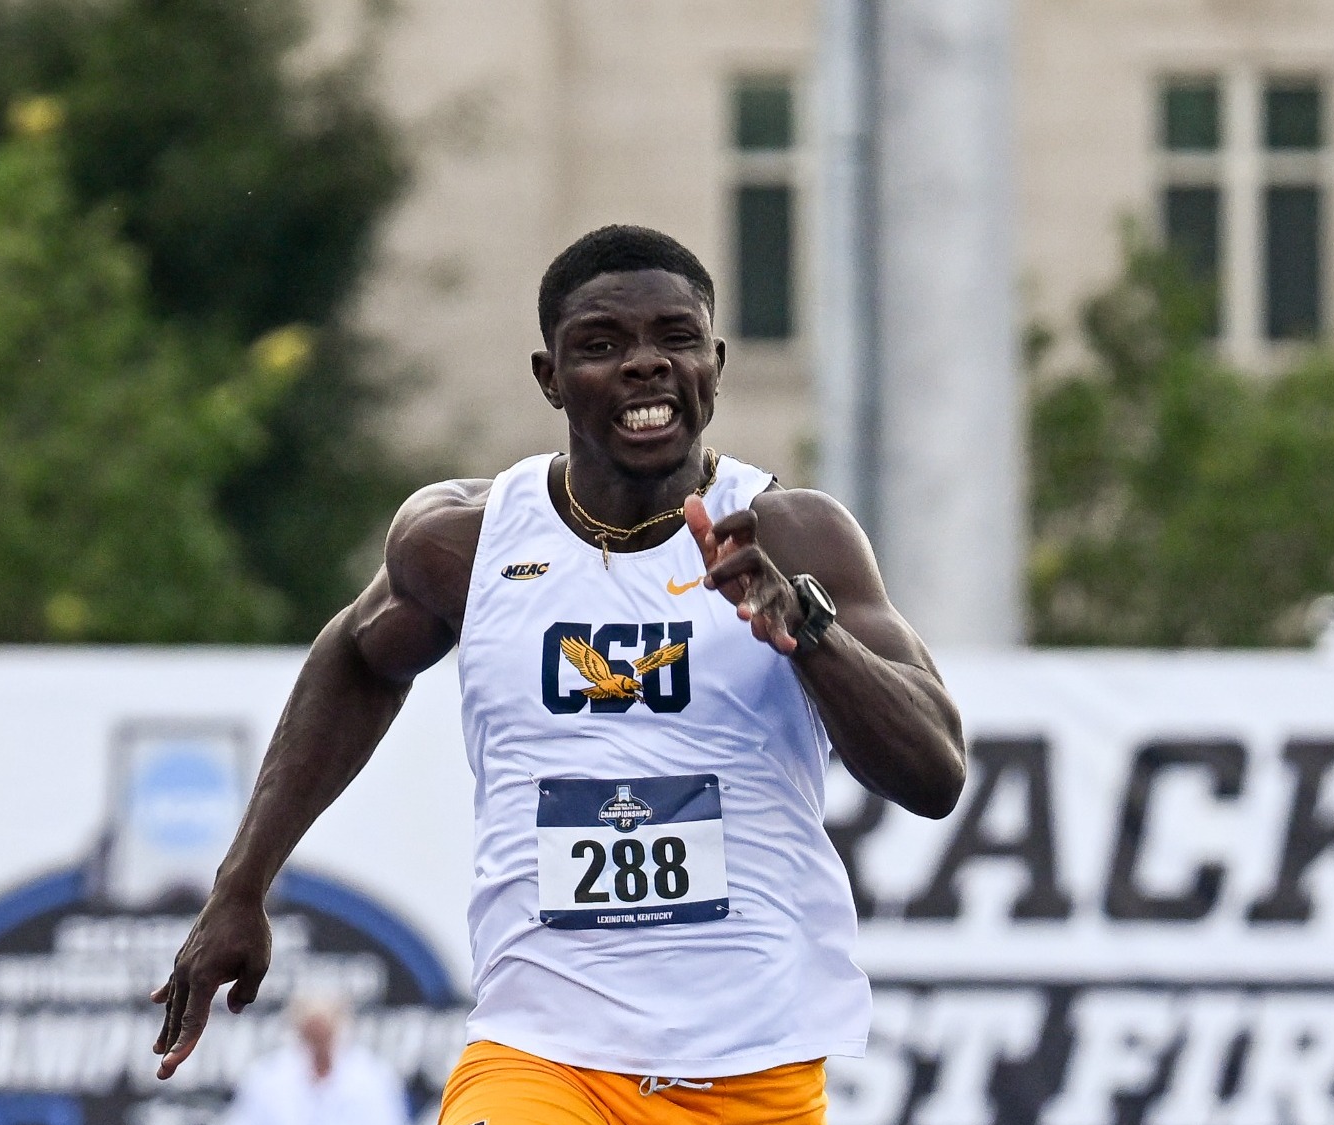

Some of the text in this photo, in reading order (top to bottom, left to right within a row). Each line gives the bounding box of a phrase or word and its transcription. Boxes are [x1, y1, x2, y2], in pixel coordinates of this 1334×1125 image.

[505, 562, 550, 577] MEAC
[542, 620, 693, 715] CSU
[571, 837, 690, 904] 288
[637, 911, 673, 922] KENTUCKY
